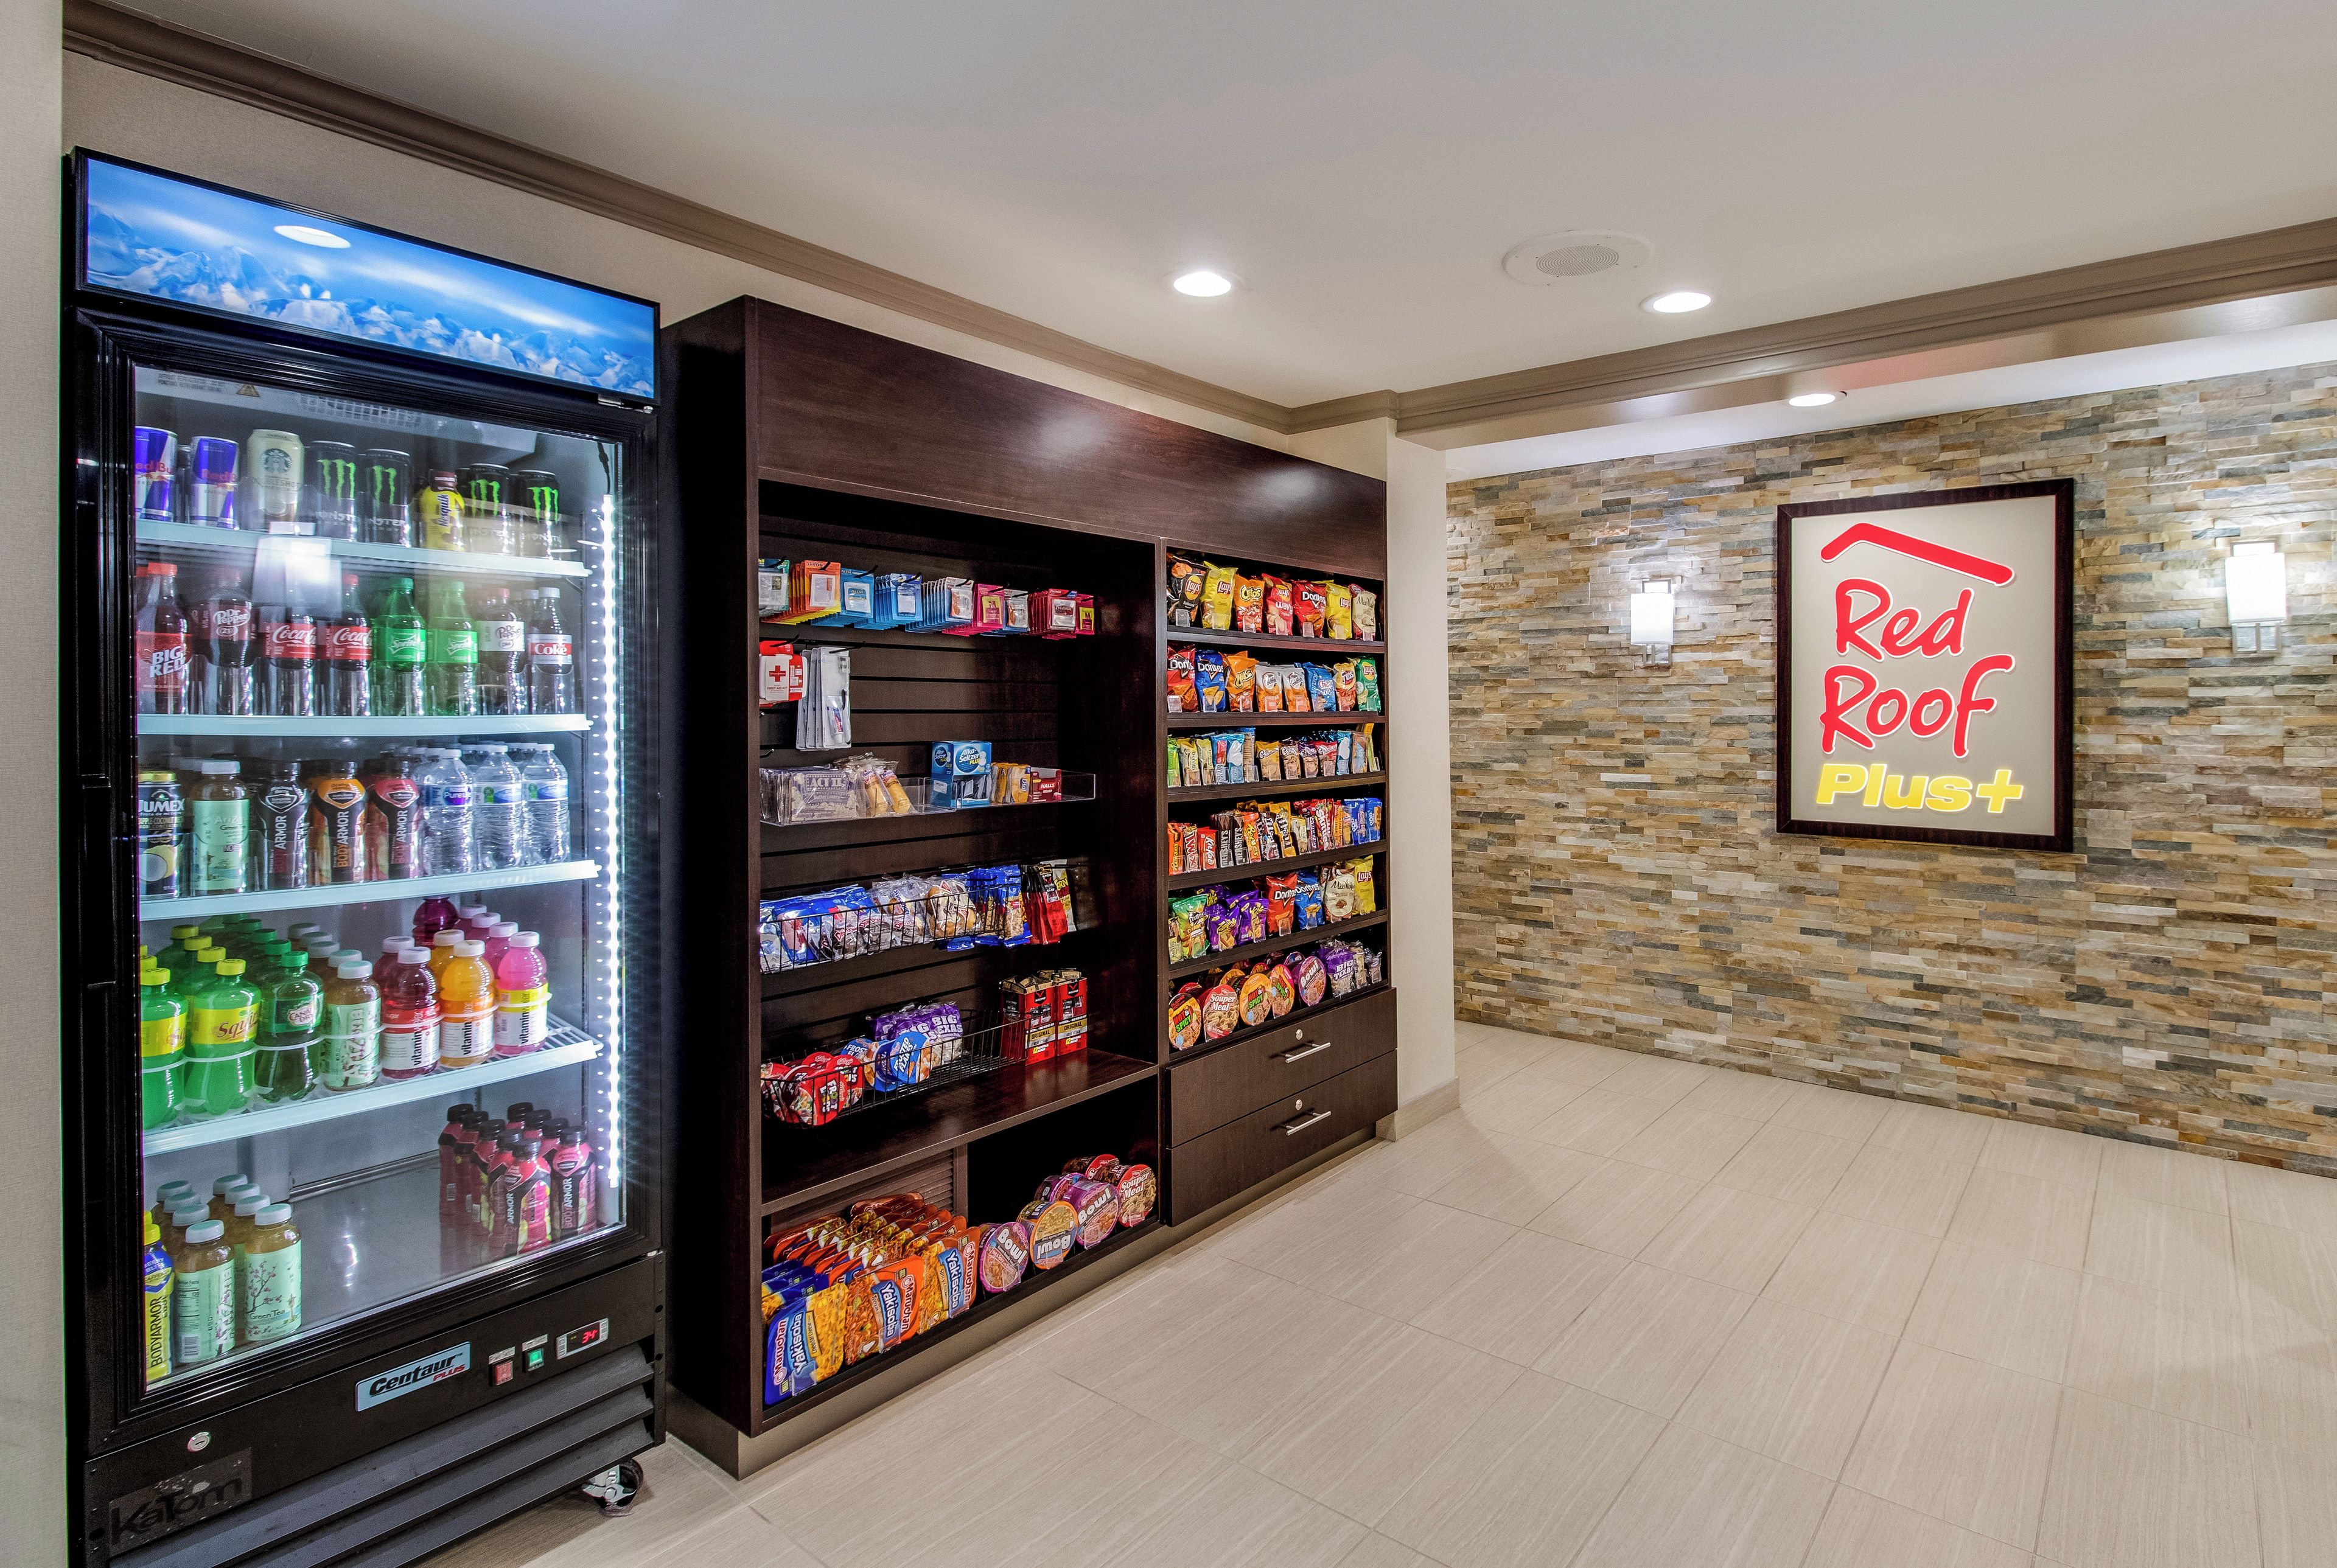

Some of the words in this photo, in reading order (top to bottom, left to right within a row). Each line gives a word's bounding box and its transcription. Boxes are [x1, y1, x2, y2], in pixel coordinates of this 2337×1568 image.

[436, 493, 450, 527] Nesquik
[1302, 591, 1327, 605] Doritos
[213, 610, 251, 627] Pepper
[1835, 578, 1974, 662] Red
[152, 646, 184, 666] BIG
[534, 643, 568, 656] Coke
[150, 657, 185, 678] RED
[1820, 653, 2015, 759] Roof
[959, 753, 980, 763] Seltzer
[810, 778, 829, 787] ACT
[139, 798, 185, 813] JUMEX
[1184, 831, 1198, 868] TWIX
[1296, 883, 1320, 894] Doritos
[1301, 960, 1319, 988] Bowl
[1336, 960, 1354, 972] BIG
[1209, 992, 1236, 1003] Souper
[1211, 1002, 1230, 1012] Meal
[1248, 995, 1263, 1009] SPICY
[932, 1014, 957, 1026] BIG
[938, 1024, 963, 1033] EXAS
[1064, 1021, 1083, 1031] ORIGINAL
[1175, 1014, 1192, 1033] SPICY
[1031, 1029, 1050, 1039] ORIGINAL
[1120, 1172, 1150, 1193] Souper
[1123, 1182, 1145, 1200] Meal
[1078, 1188, 1111, 1225] Bowl
[997, 1228, 1028, 1264] Bowl
[1036, 1235, 1072, 1260] Bowl
[947, 1250, 961, 1309] Yakisoba
[964, 1252, 976, 1303] Maruchan
[250, 1311, 271, 1320] Green
[271, 1308, 285, 1317] Tea
[882, 1281, 897, 1337] Yakisoba
[902, 1284, 913, 1332] Maruchan
[150, 1297, 164, 1368] BODYARMOR
[774, 1317, 789, 1376] Maruchan
[791, 1311, 808, 1376] Yakisoba
[369, 1352, 458, 1397] Centaur
[433, 1364, 466, 1382] PLUS
